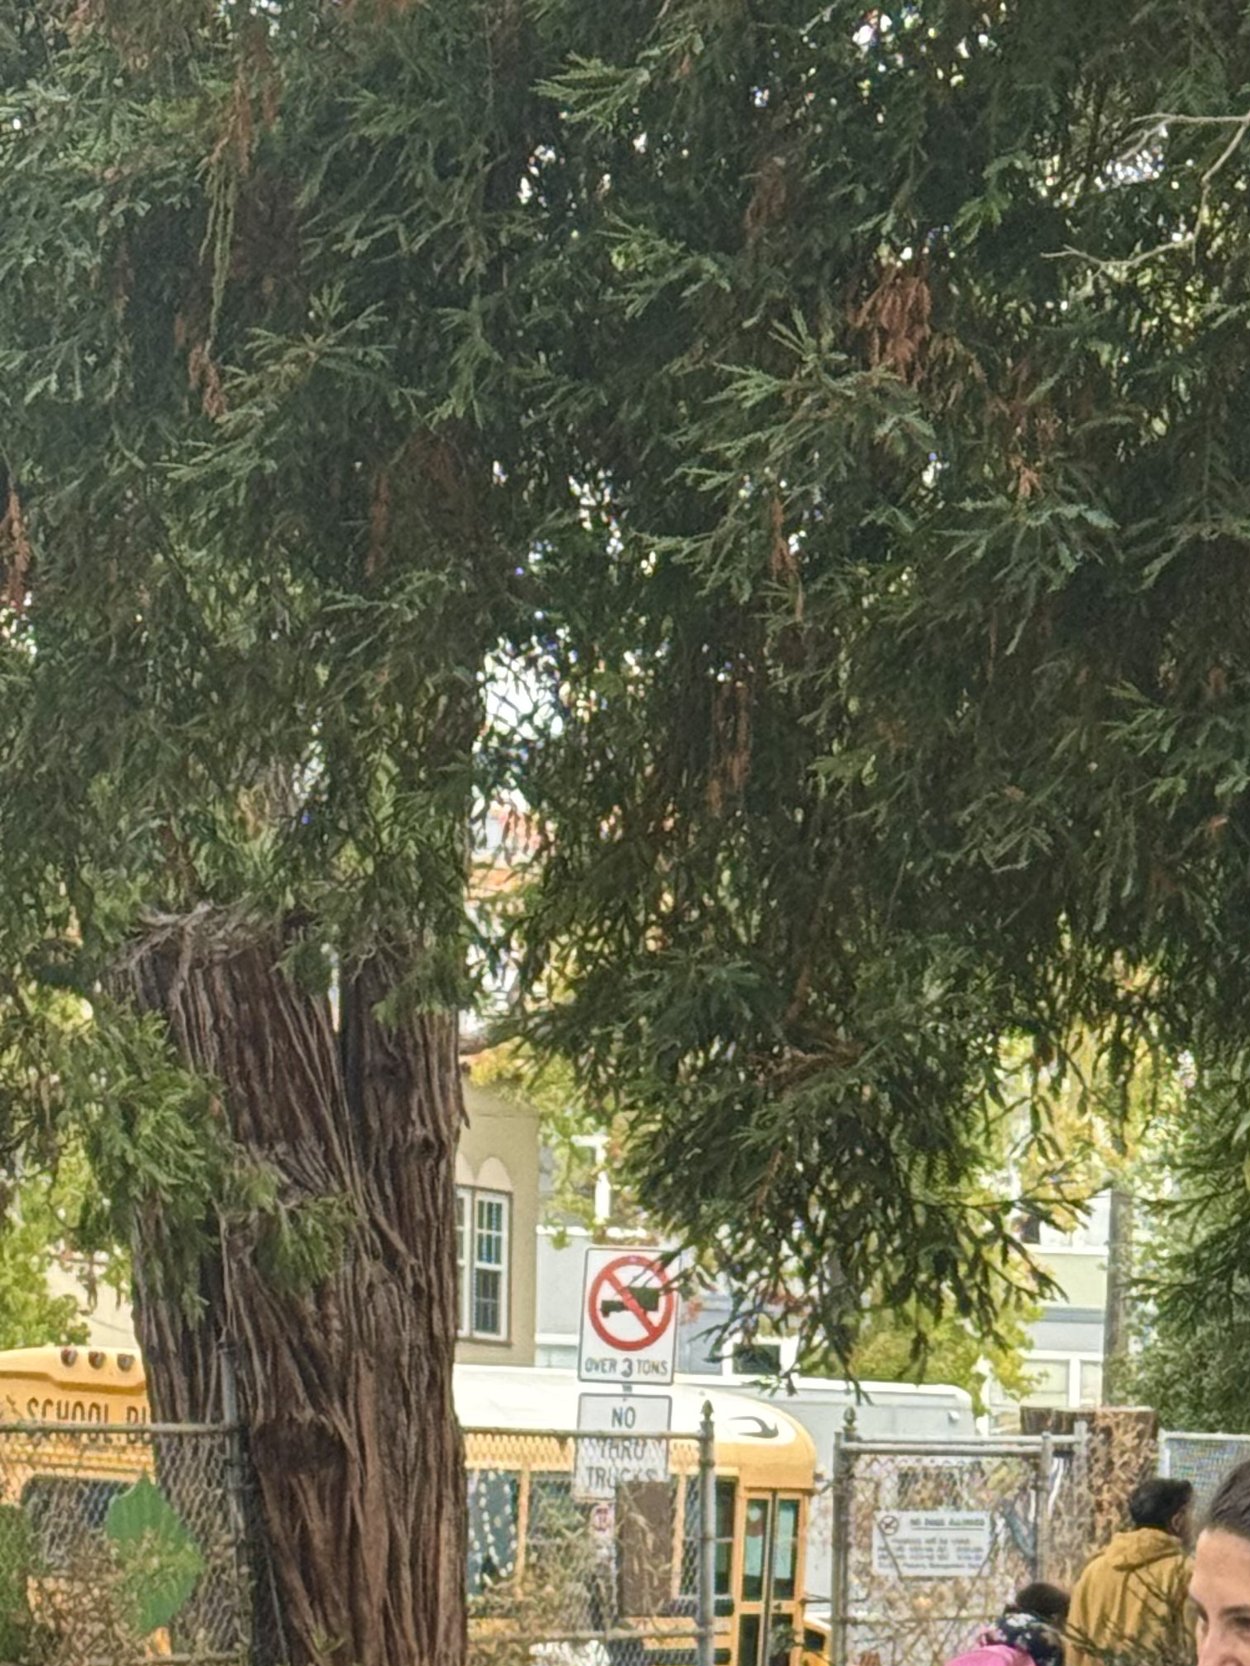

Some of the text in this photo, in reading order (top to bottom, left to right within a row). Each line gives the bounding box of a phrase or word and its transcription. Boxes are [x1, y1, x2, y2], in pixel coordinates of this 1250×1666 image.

[585, 1357, 668, 1378] OVER 3 TONS
[26, 1396, 151, 1445] SCHOOL BU
[611, 1406, 636, 1429] NO
[598, 1437, 647, 1461] THRU
[586, 1466, 658, 1490] TRUCKS
